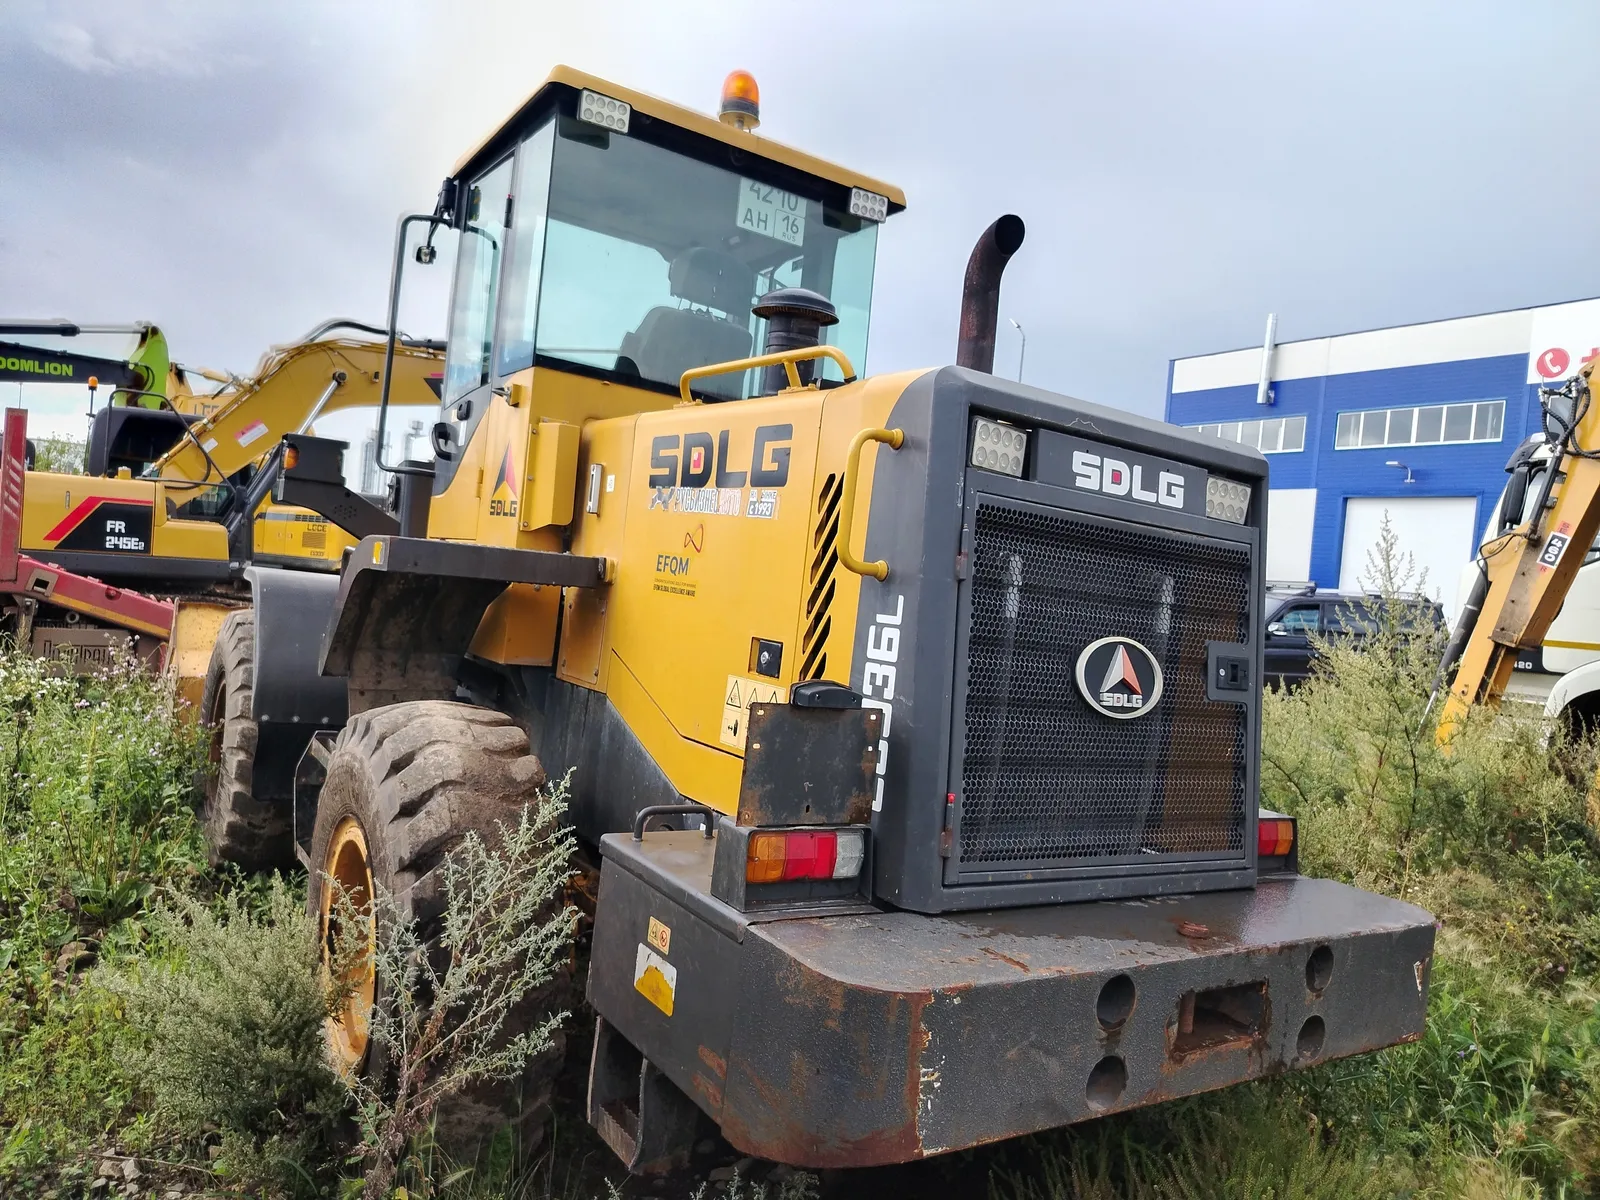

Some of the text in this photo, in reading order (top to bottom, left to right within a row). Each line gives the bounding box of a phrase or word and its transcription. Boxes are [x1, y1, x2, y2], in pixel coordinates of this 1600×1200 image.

[782, 215, 799, 234] 16
[782, 232, 797, 242] RUS
[649, 423, 794, 489] SDLG
[1072, 450, 1185, 509] SDLG
[490, 500, 518, 517] SDLG
[106, 520, 126, 533] FR
[656, 554, 690, 576] EFQM
[861, 594, 905, 813] 36L
[1100, 692, 1143, 709] SDLG
